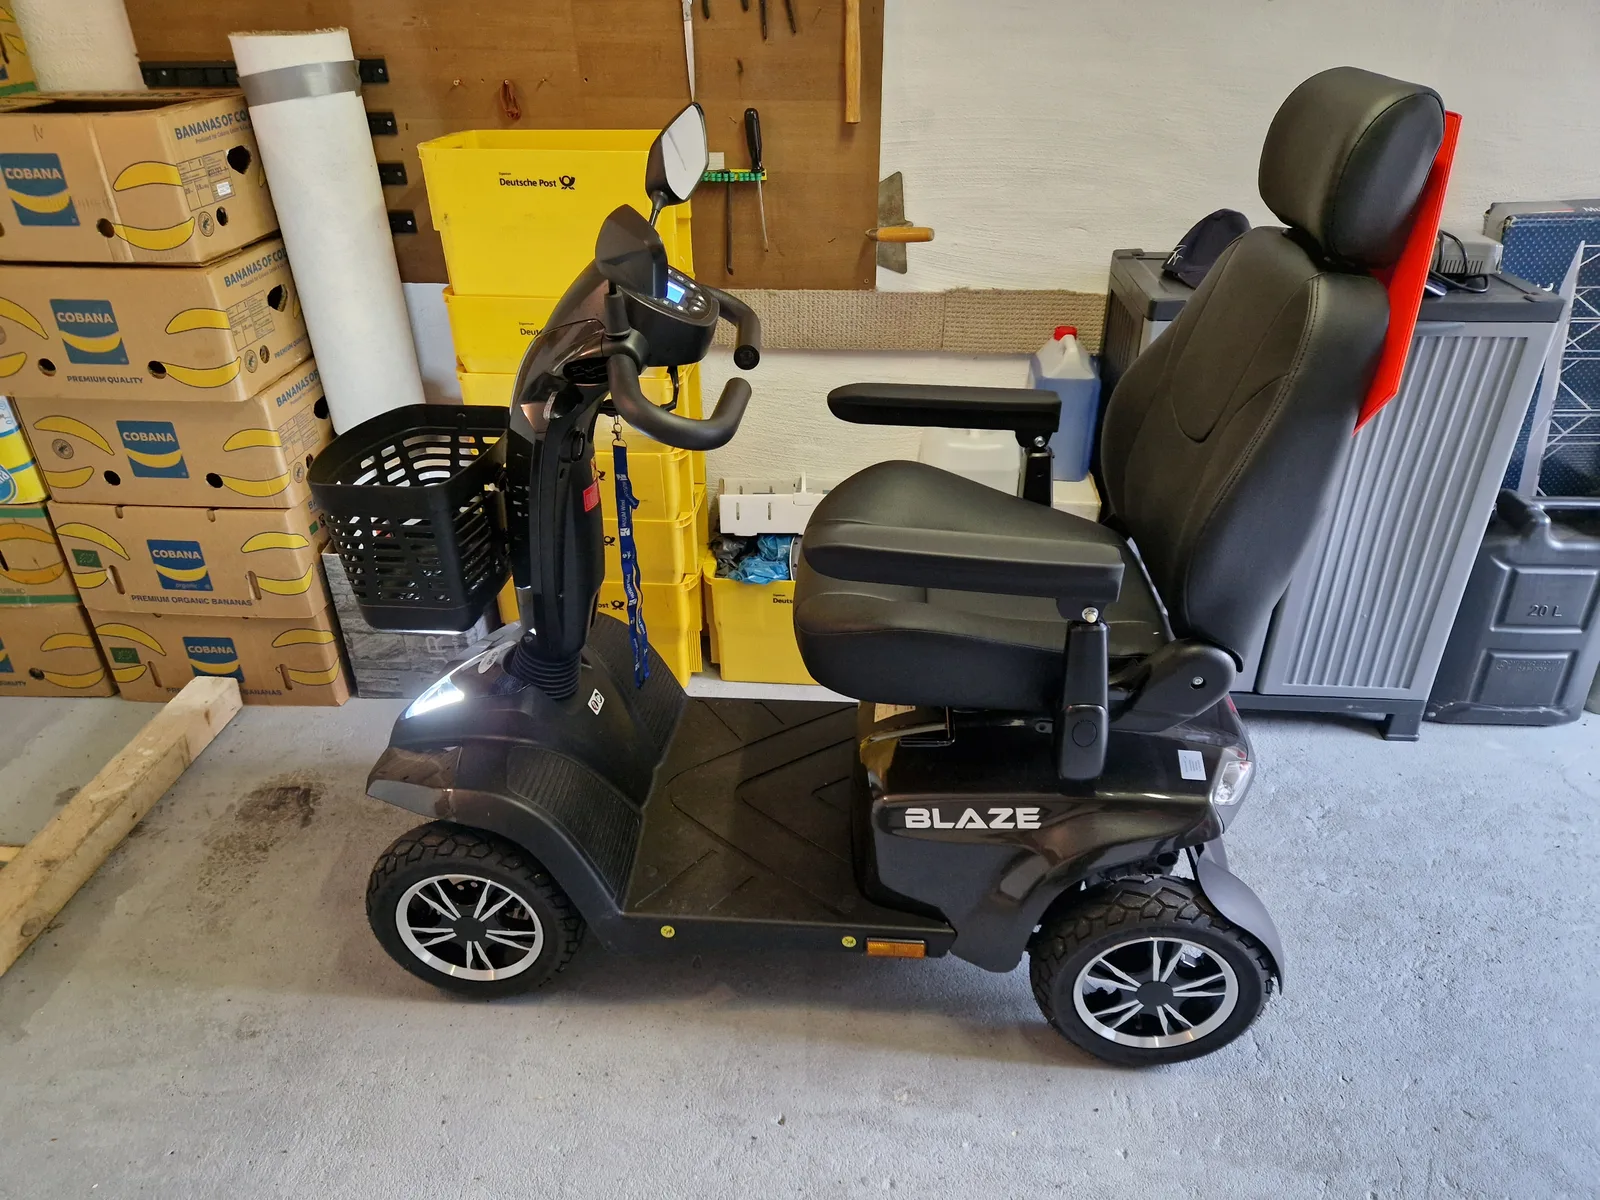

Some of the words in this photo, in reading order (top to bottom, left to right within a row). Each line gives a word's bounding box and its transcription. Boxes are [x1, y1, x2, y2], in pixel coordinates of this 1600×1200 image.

[174, 116, 222, 140] BANANAS
[221, 113, 233, 127] OF
[5, 167, 62, 180] COBANA
[499, 177, 538, 187] Deutsche
[538, 179, 557, 187] Post
[223, 260, 263, 288] BANANAS
[261, 254, 273, 268] OF
[56, 311, 114, 324] COBANA
[66, 375, 107, 383] PREMIUM
[107, 376, 144, 384] QUALITY
[275, 375, 310, 408] BANANAS
[122, 431, 176, 442] COBANA
[151, 549, 202, 560] COBANA
[131, 594, 170, 603] PREMIUM
[171, 596, 210, 605] ORGANIC
[211, 598, 253, 607] BANANAS
[1527, 604, 1549, 617] 20
[1552, 605, 1562, 617] L
[187, 645, 235, 654] COBANA
[904, 807, 1042, 829] BLAZE
